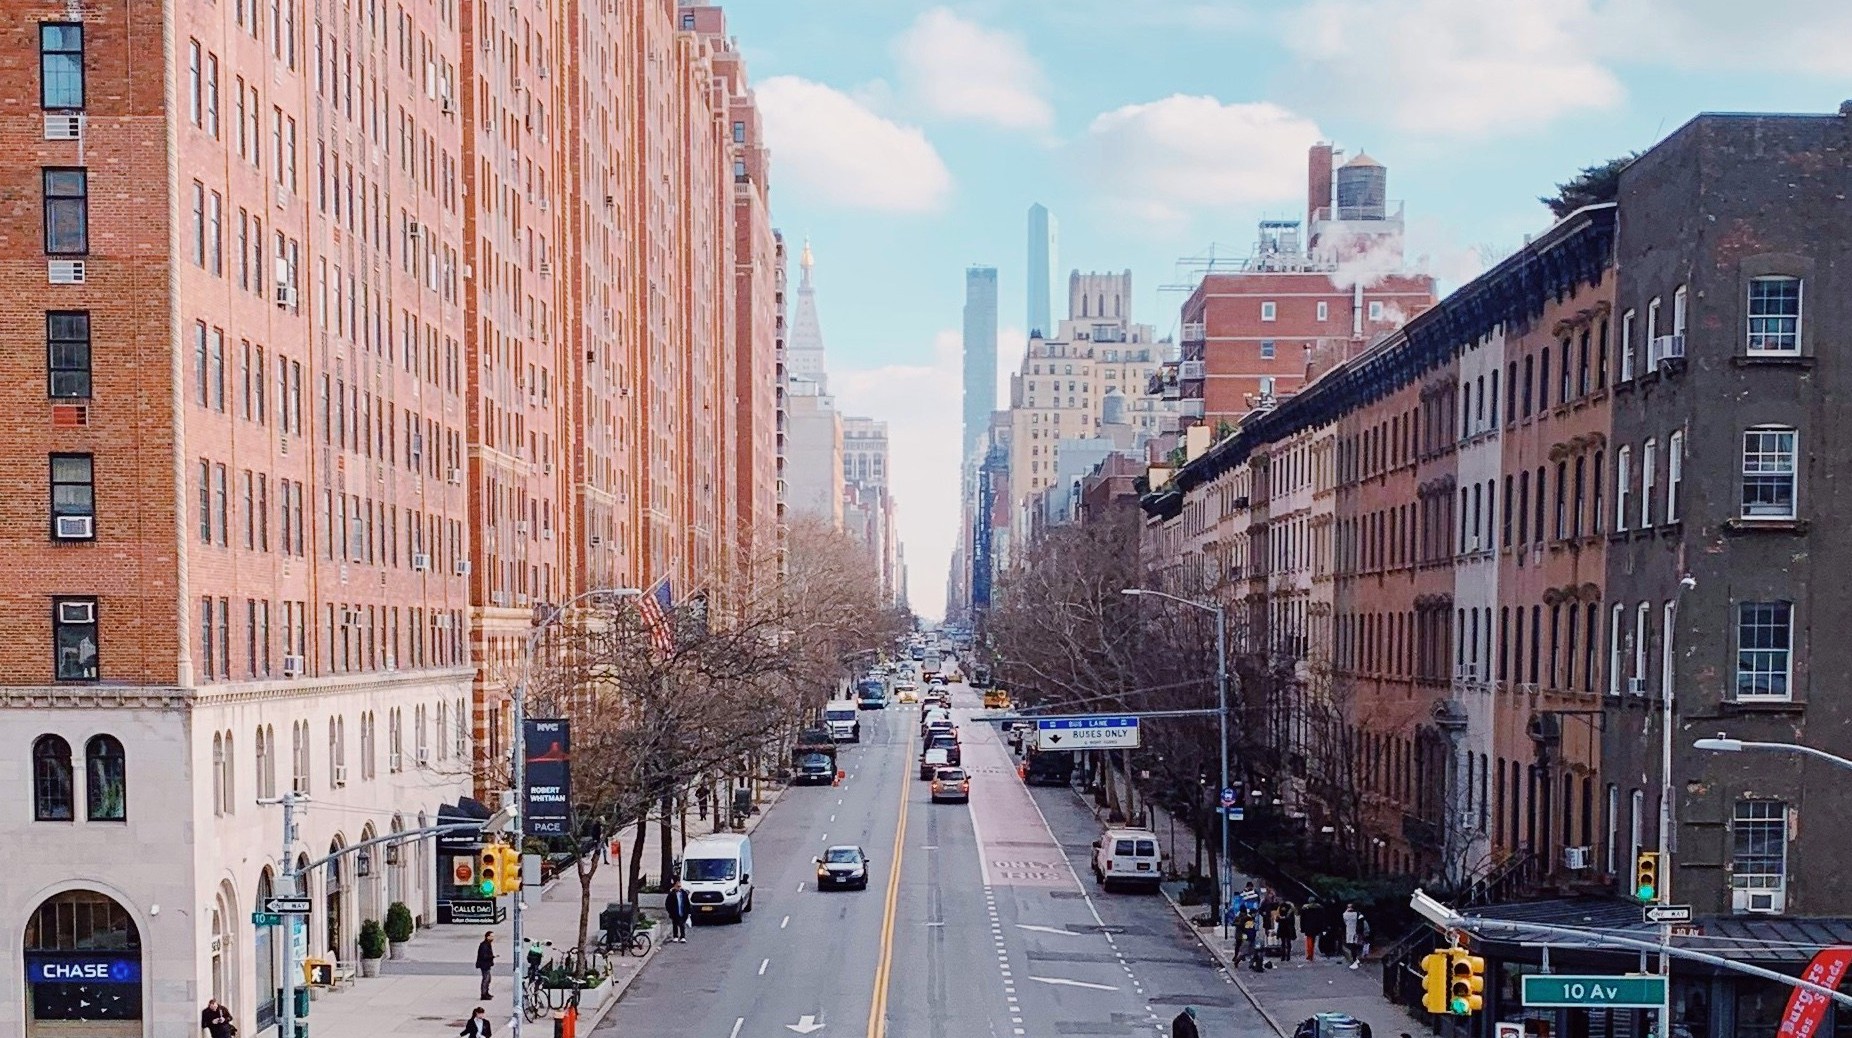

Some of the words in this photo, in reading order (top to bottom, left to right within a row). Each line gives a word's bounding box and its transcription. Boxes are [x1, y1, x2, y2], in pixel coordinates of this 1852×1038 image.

[536, 723, 559, 731] NYC
[1068, 720, 1082, 728] BUS
[1088, 719, 1108, 727] LANE
[1072, 730, 1102, 738] BUSES
[1105, 729, 1128, 738] ONLY
[530, 786, 560, 794] ROBERT
[534, 823, 561, 831] PACE
[255, 914, 266, 923] 10
[43, 963, 109, 978] CHASE
[1814, 959, 1844, 1004] Slads
[1563, 983, 1585, 999] 10
[1589, 983, 1618, 999] Av
[1781, 963, 1824, 1035] Burgrs
